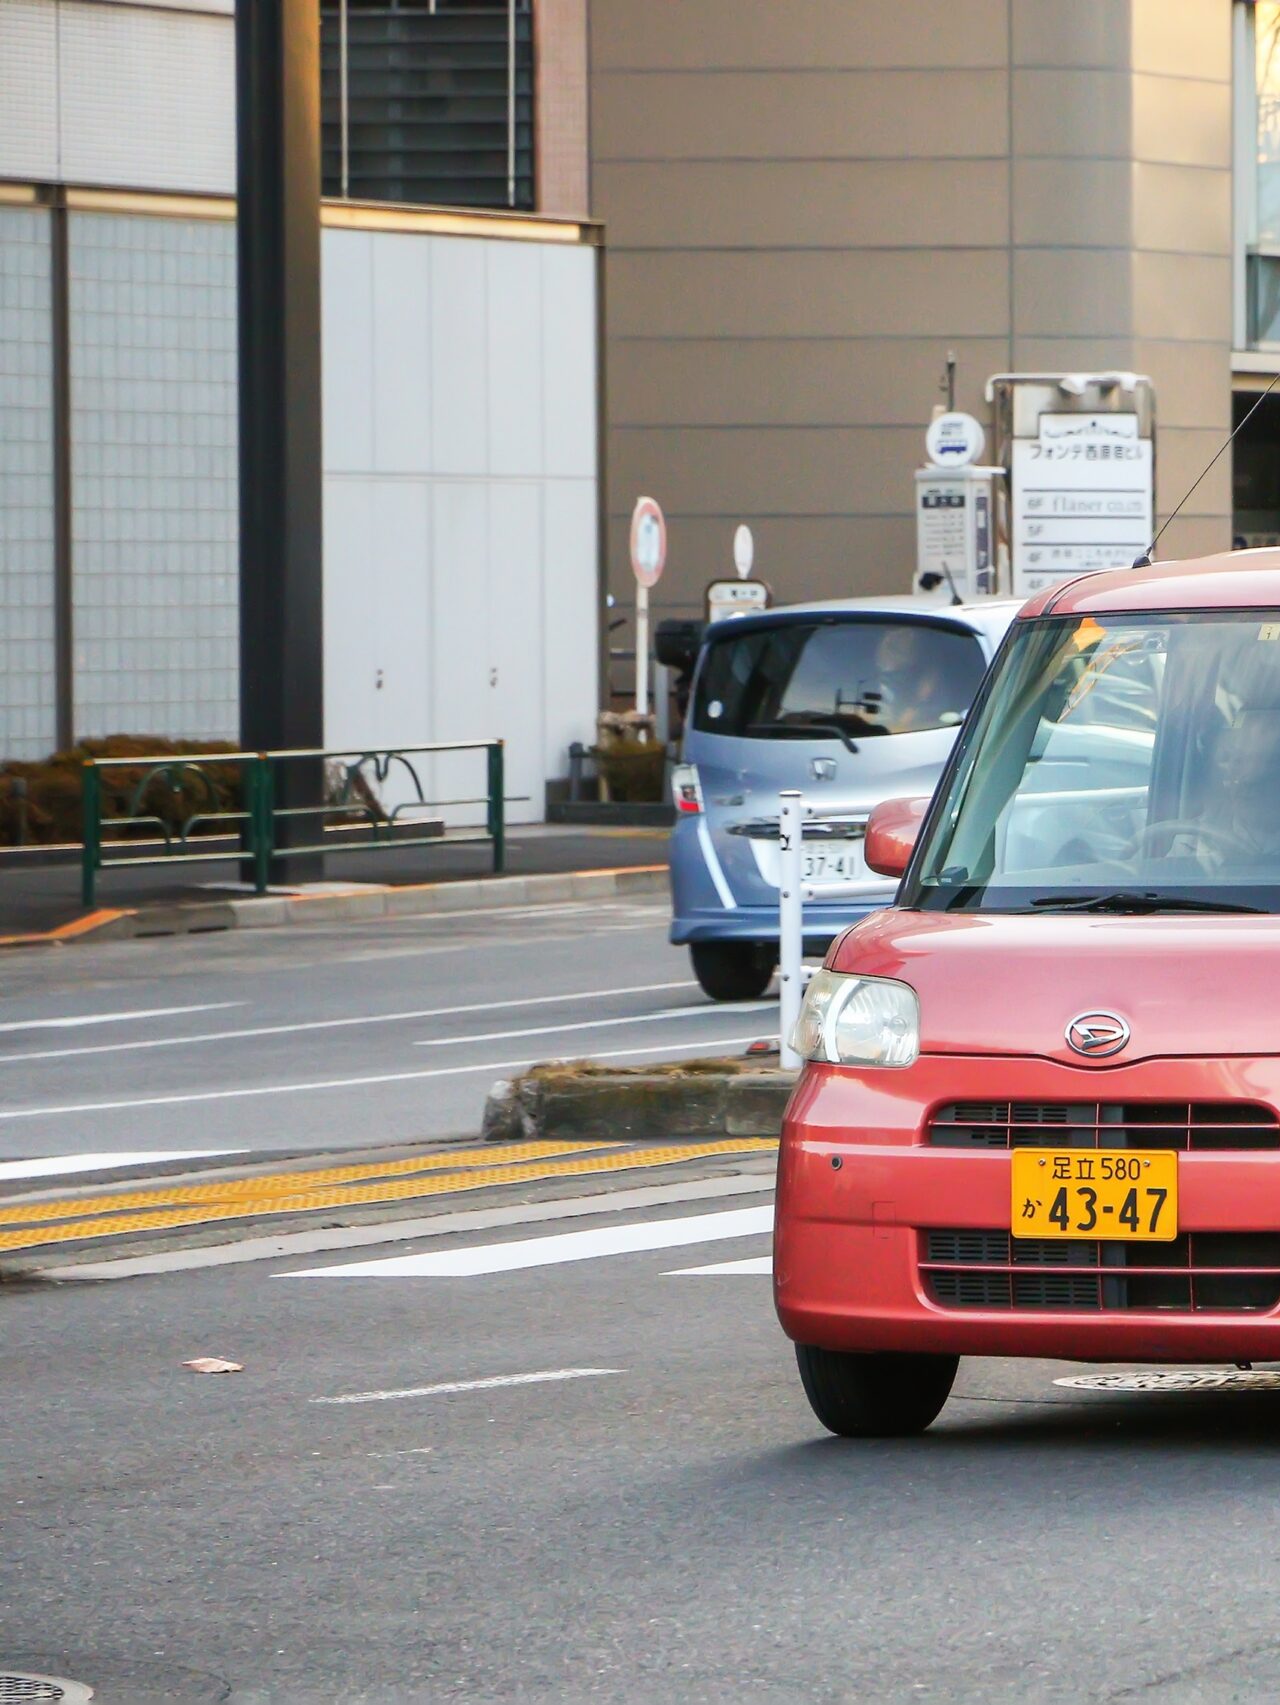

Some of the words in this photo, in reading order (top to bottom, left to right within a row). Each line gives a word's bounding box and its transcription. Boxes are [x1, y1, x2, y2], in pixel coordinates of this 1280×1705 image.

[1052, 1156, 1096, 1180] 足立
[1101, 1157, 1141, 1181] 580
[1022, 1198, 1042, 1218] か
[1048, 1186, 1168, 1232] 43-47
